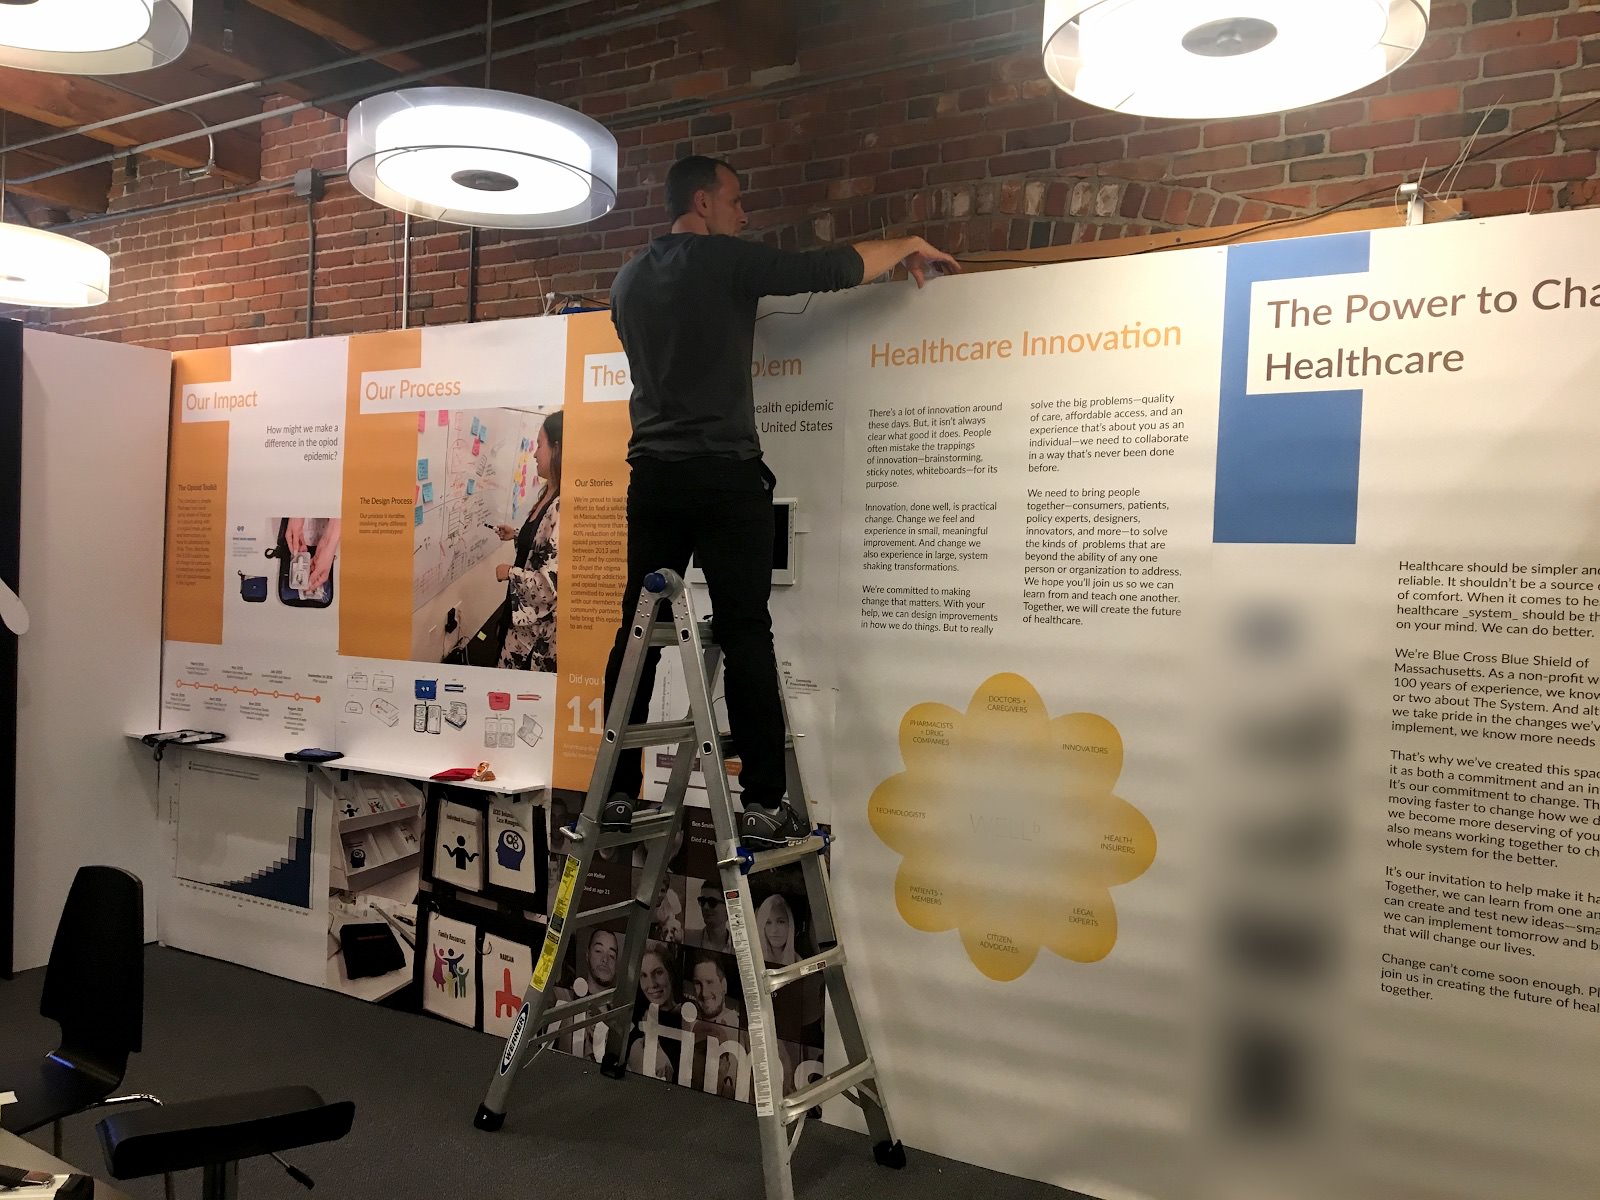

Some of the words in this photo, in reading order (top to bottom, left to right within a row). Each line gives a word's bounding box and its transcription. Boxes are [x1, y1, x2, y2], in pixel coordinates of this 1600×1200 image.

[1268, 299, 1332, 328] The
[1346, 294, 1466, 323] Power
[1477, 287, 1518, 314] to
[871, 337, 1012, 368] Healthcare
[1022, 321, 1181, 357] Innovation
[1266, 347, 1464, 381] Healthcare
[591, 365, 626, 386] The
[366, 381, 395, 400] Our
[400, 379, 461, 399] Process
[186, 393, 210, 410] Our
[214, 390, 258, 412] Impact
[754, 401, 781, 413] ealth
[785, 400, 834, 414] epidemic
[1030, 400, 1054, 410] solve
[1056, 399, 1071, 408] the
[1073, 398, 1088, 409] big
[904, 408, 915, 416] lot
[917, 406, 926, 415] of
[927, 405, 971, 414] innovation
[972, 402, 1003, 412] around
[267, 425, 282, 434] How
[284, 424, 302, 435] might
[315, 424, 332, 432] make
[762, 421, 796, 432] United
[800, 421, 832, 432] States
[265, 439, 296, 448] difference
[306, 438, 317, 447] the
[1096, 435, 1120, 445] need
[1122, 436, 1132, 444] to
[1134, 433, 1189, 444] collaborate
[867, 444, 888, 453] often
[889, 442, 920, 452] mistake
[921, 442, 935, 451] the
[937, 441, 975, 452] trappings
[304, 451, 338, 462] epidemic?
[590, 479, 613, 487] Stories
[1027, 488, 1043, 498] We
[1044, 488, 1068, 498] need
[1069, 488, 1080, 498] to
[1081, 487, 1106, 499] bring
[1107, 487, 1141, 499] people
[372, 497, 390, 506] Design
[910, 502, 931, 511] done
[961, 502, 997, 512] practical
[1026, 526, 1075, 537] innovators,
[1077, 526, 1095, 536] and
[1142, 526, 1168, 536] solve
[1399, 560, 1464, 572] Healthcare
[1467, 562, 1508, 573] should
[1511, 562, 1528, 574] be
[1531, 563, 1579, 577] simpler
[1396, 604, 1459, 617] healthcare
[1522, 608, 1565, 621] should
[1569, 610, 1585, 622] be
[1022, 614, 1033, 623] of
[1034, 614, 1083, 626] healthcare.
[1433, 649, 1460, 662] Blue
[1463, 651, 1498, 664] Cross
[1501, 653, 1529, 666] Blue
[1532, 655, 1572, 668] Shield
[1575, 658, 1590, 669] of
[1394, 662, 1485, 678] Massachusetts.
[1488, 668, 1504, 679] As
[1518, 672, 1584, 684] non-profit
[569, 673, 582, 684] Did
[584, 677, 598, 686] you
[989, 695, 1020, 704] DOCTORS
[987, 704, 1027, 713] CAREGIVERS
[910, 720, 953, 729] PHARMACISTS
[912, 737, 950, 746] COMPANIES
[1062, 744, 1109, 754] INNOVATORS
[876, 807, 926, 819] TECHNOLOGISTS
[1104, 834, 1132, 844] HEALTH
[1101, 844, 1135, 854] INSURERS
[910, 886, 938, 896] PATIENTS
[912, 895, 942, 905] MEMBERS
[1073, 908, 1094, 917] LEGAL
[1069, 916, 1098, 927] EXPERTS
[987, 933, 1012, 944] CITIZEN
[980, 941, 1018, 953] ADVOCATES
[1381, 953, 1426, 970] Change
[1461, 968, 1495, 981] come
[1498, 974, 1529, 986] soon
[1532, 979, 1584, 996] enough.
[1381, 982, 1432, 1000] together.
[506, 1016, 525, 1060] WERNER
